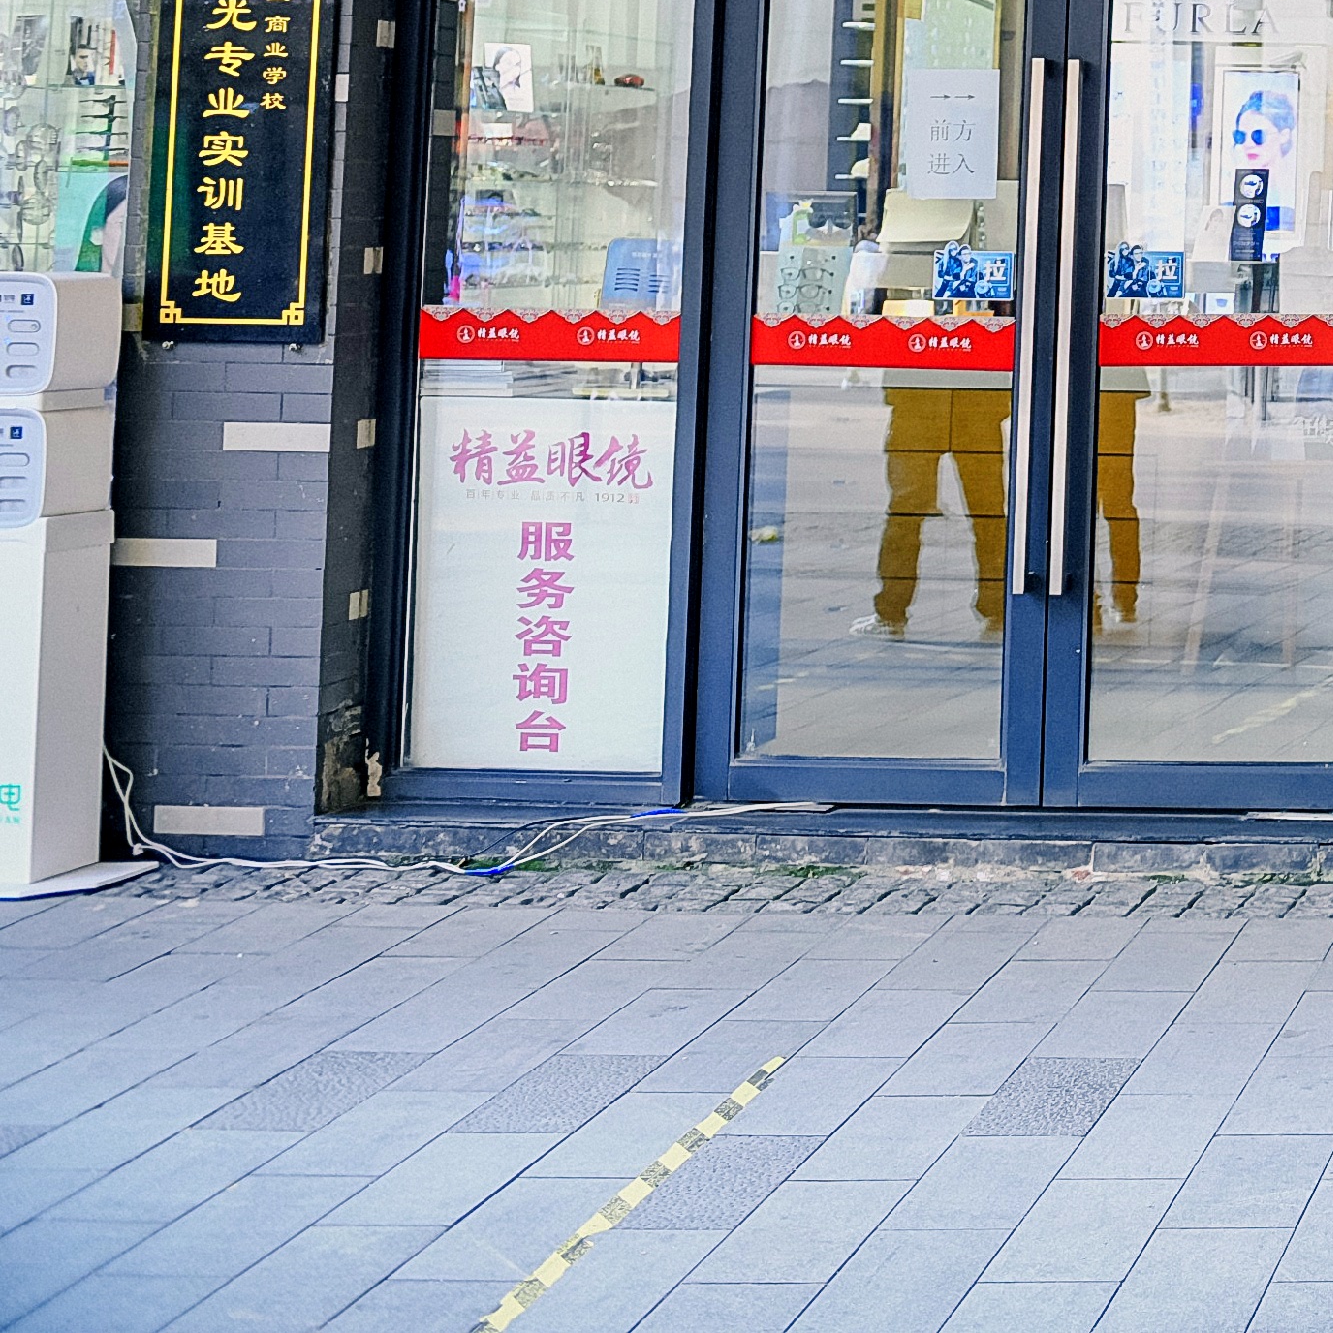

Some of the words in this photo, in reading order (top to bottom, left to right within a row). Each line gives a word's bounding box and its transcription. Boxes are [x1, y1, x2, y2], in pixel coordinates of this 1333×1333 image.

[1124, 3, 1280, 36] FURLA
[928, 118, 974, 142] 前方
[926, 153, 976, 176] 进入
[984, 260, 1007, 282] 拉
[1156, 258, 1179, 281] 拉
[450, 429, 653, 489] 精益眼镜
[594, 492, 626, 504] 1912
[512, 521, 575, 754] 服务咨询台
